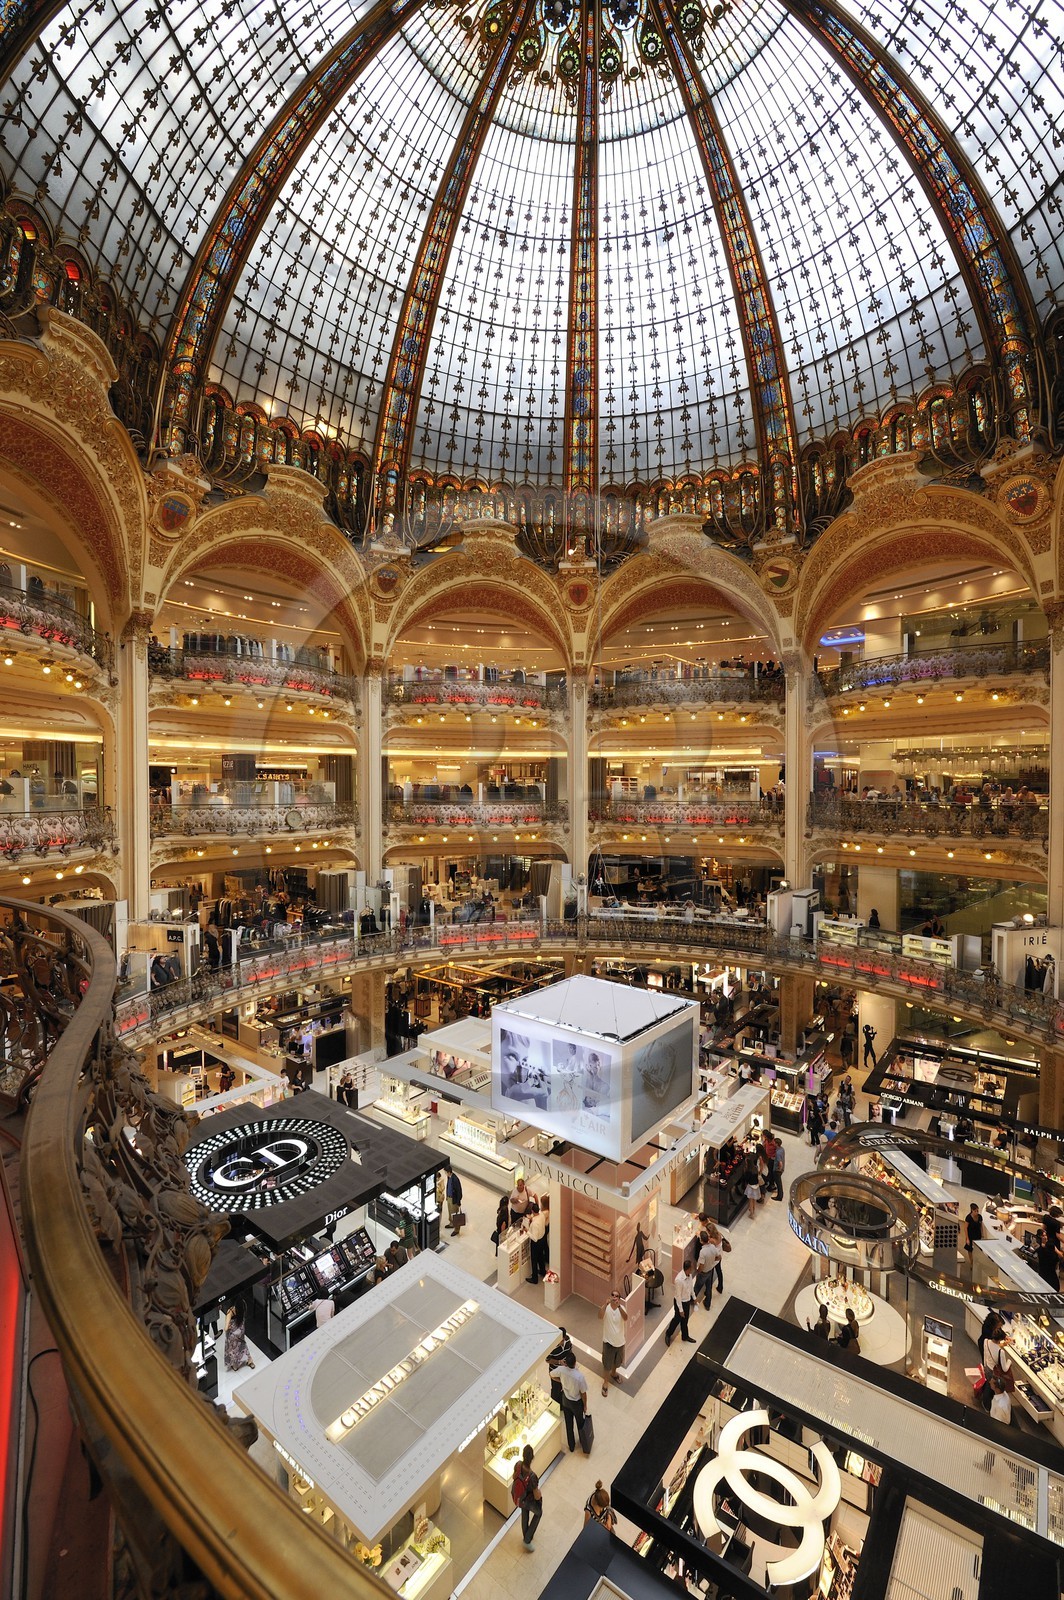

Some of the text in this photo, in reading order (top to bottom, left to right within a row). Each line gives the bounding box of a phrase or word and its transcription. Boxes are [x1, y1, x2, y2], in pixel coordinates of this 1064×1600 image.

[880, 1092, 924, 1108] GIORGIO ARMANI
[859, 1138, 919, 1147] GUERLAIN
[1023, 1127, 1052, 1140] RALPH
[213, 1139, 308, 1187] CD
[518, 1152, 599, 1200] NINA RICCI
[324, 1206, 348, 1226] Dior
[928, 1280, 974, 1302] GUERLAIN
